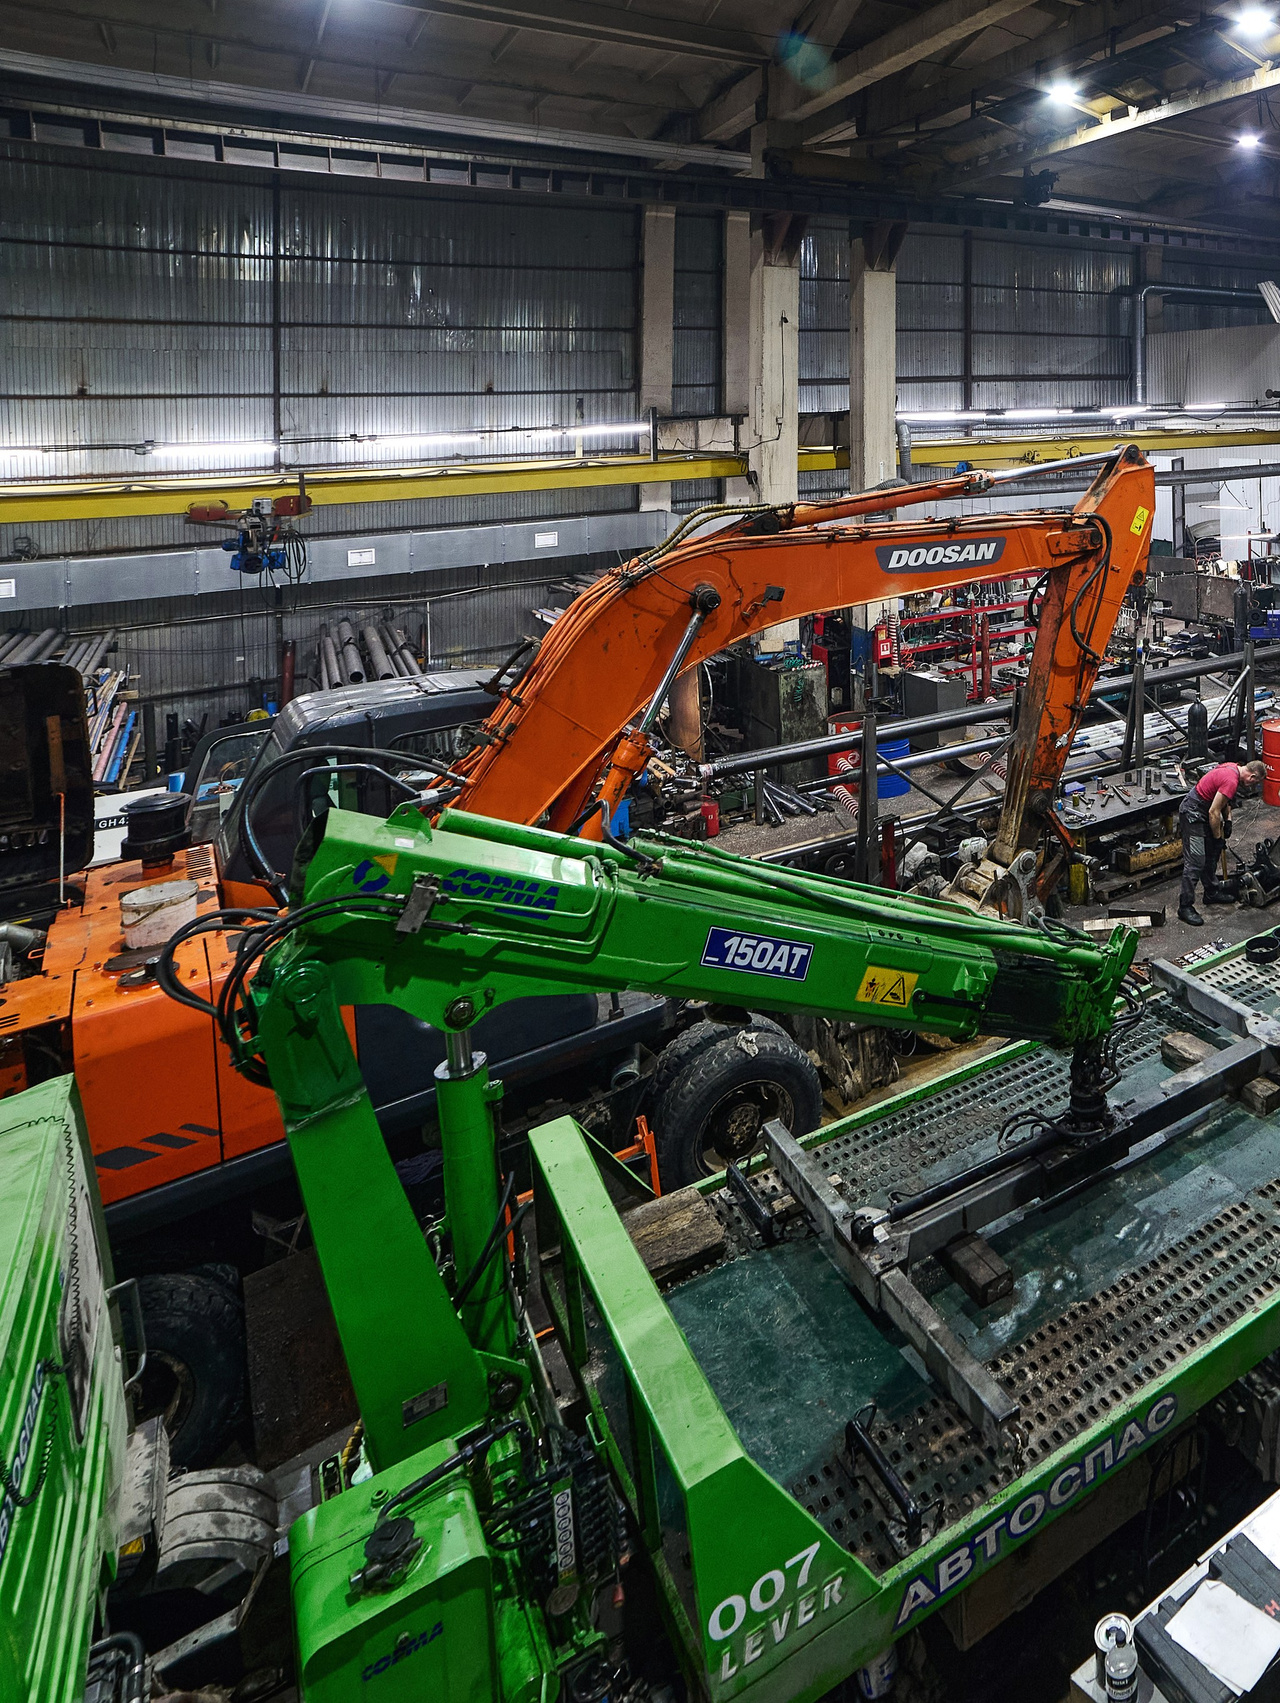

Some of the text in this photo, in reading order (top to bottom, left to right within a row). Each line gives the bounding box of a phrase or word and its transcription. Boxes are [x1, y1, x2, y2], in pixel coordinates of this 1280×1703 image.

[887, 541, 997, 569] DOOSAN
[98, 818, 117, 829] GH
[442, 868, 560, 911] COPMA
[723, 935, 809, 975] 150AT
[894, 1393, 1178, 1630] АВТОСПАС
[708, 1541, 821, 1642] 007
[720, 1568, 846, 1684] LEVER
